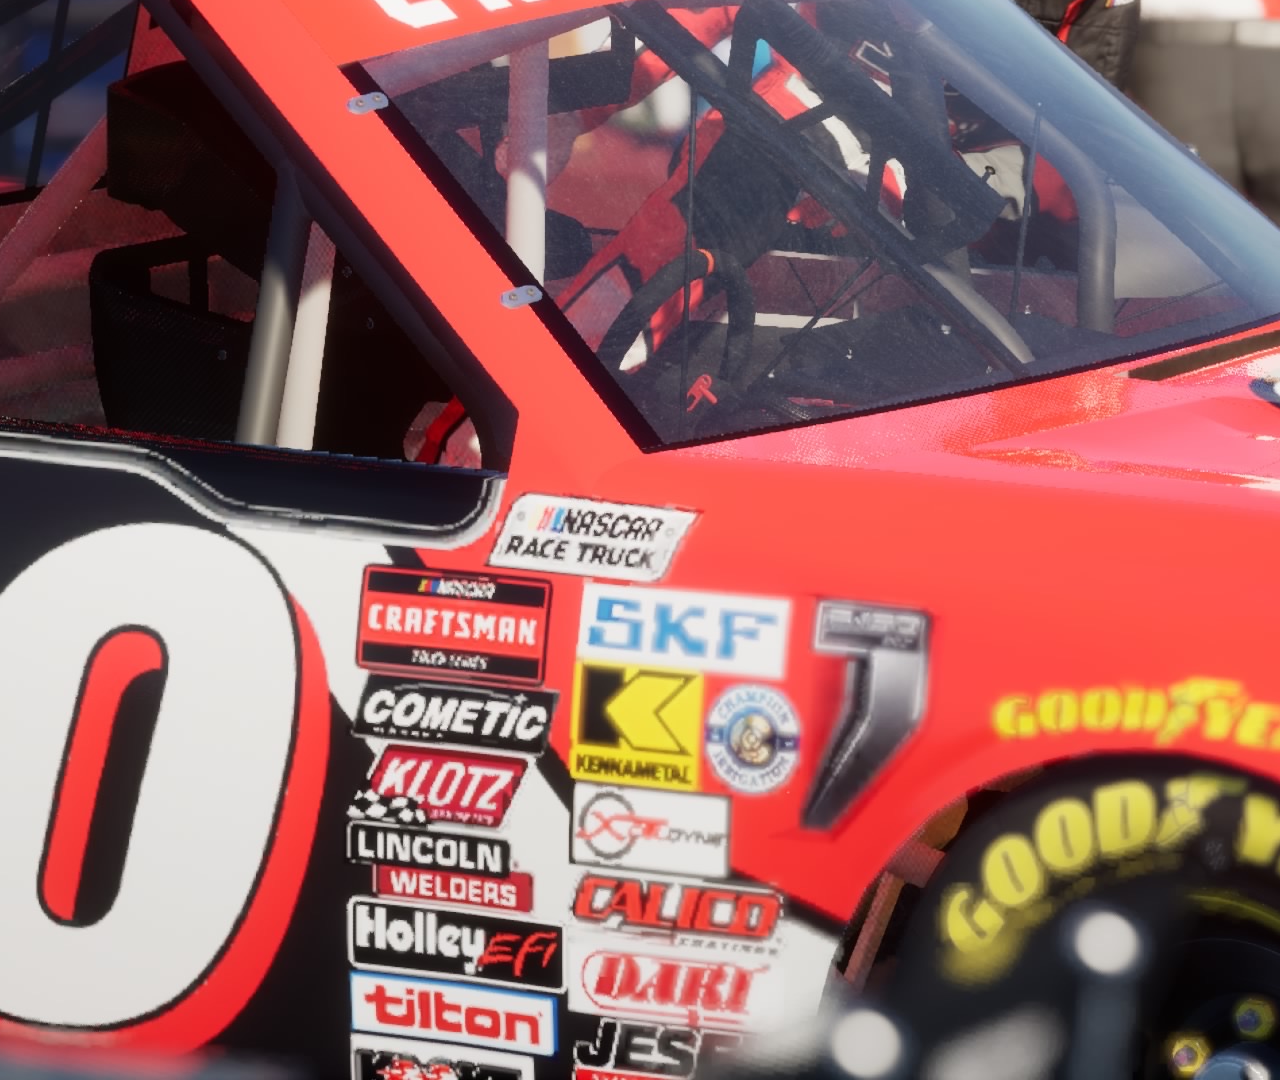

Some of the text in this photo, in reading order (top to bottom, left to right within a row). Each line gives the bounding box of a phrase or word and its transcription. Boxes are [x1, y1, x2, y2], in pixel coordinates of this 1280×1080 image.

[505, 535, 656, 569] RACE TRUCK
[562, 508, 664, 542] NASCAR
[367, 603, 538, 646] CRAFTSMAN
[588, 595, 778, 661] SKF
[363, 688, 548, 742] COMETIC
[377, 756, 514, 811] KLOTZ
[357, 829, 503, 873] LINCOLN
[389, 869, 518, 908] WELDERS
[573, 873, 781, 940] CALICO
[355, 904, 558, 978] Holley EFI
[594, 955, 764, 1015] DART
[364, 984, 540, 1046] tilton
